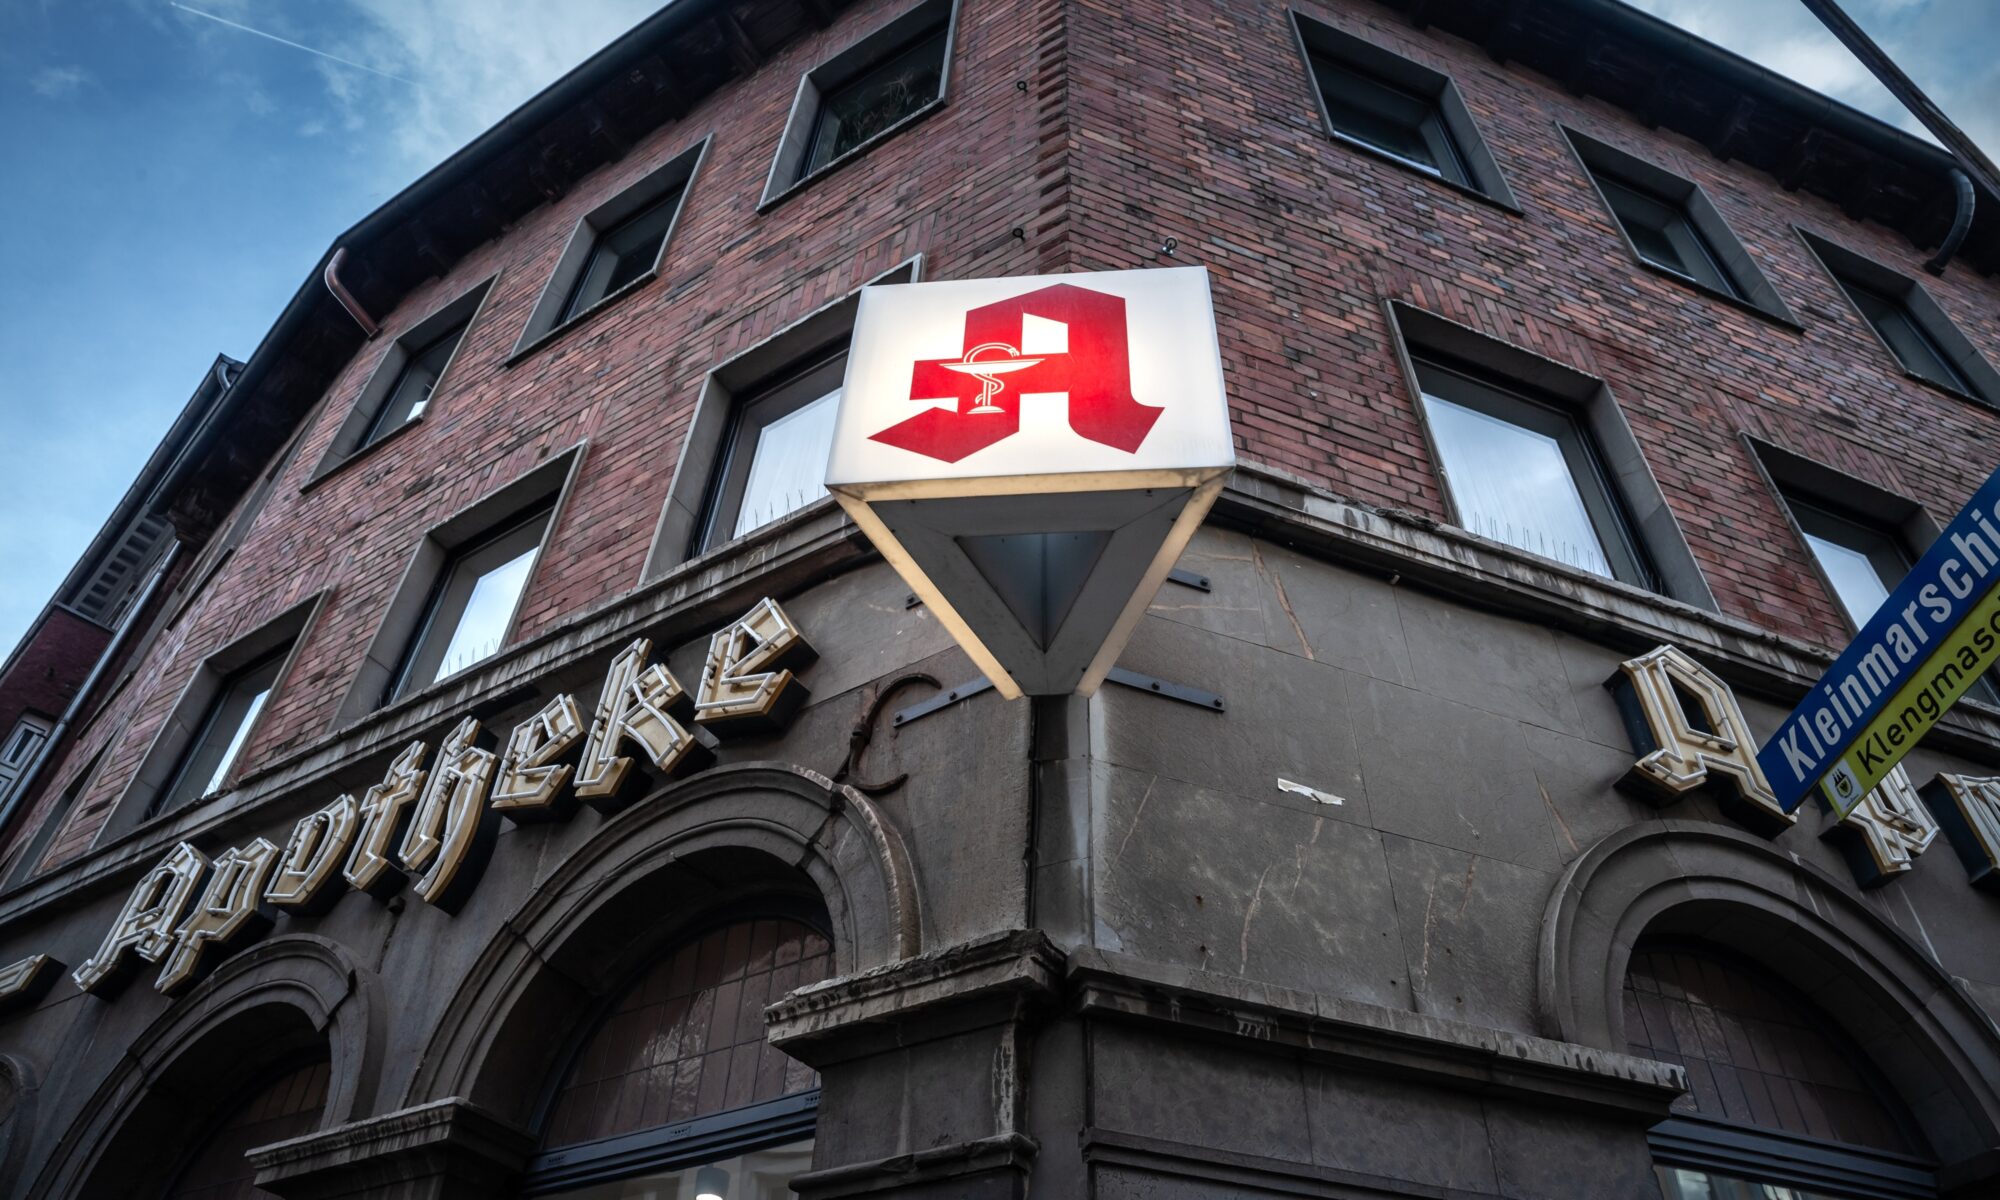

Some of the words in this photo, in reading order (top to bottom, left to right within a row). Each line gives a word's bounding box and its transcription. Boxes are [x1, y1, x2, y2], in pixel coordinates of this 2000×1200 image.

[867, 283, 1165, 464] A
[1778, 499, 2000, 783] Kleinmarschi
[1855, 593, 2000, 776] Klengmas
[71, 596, 800, 994] Apotheke
